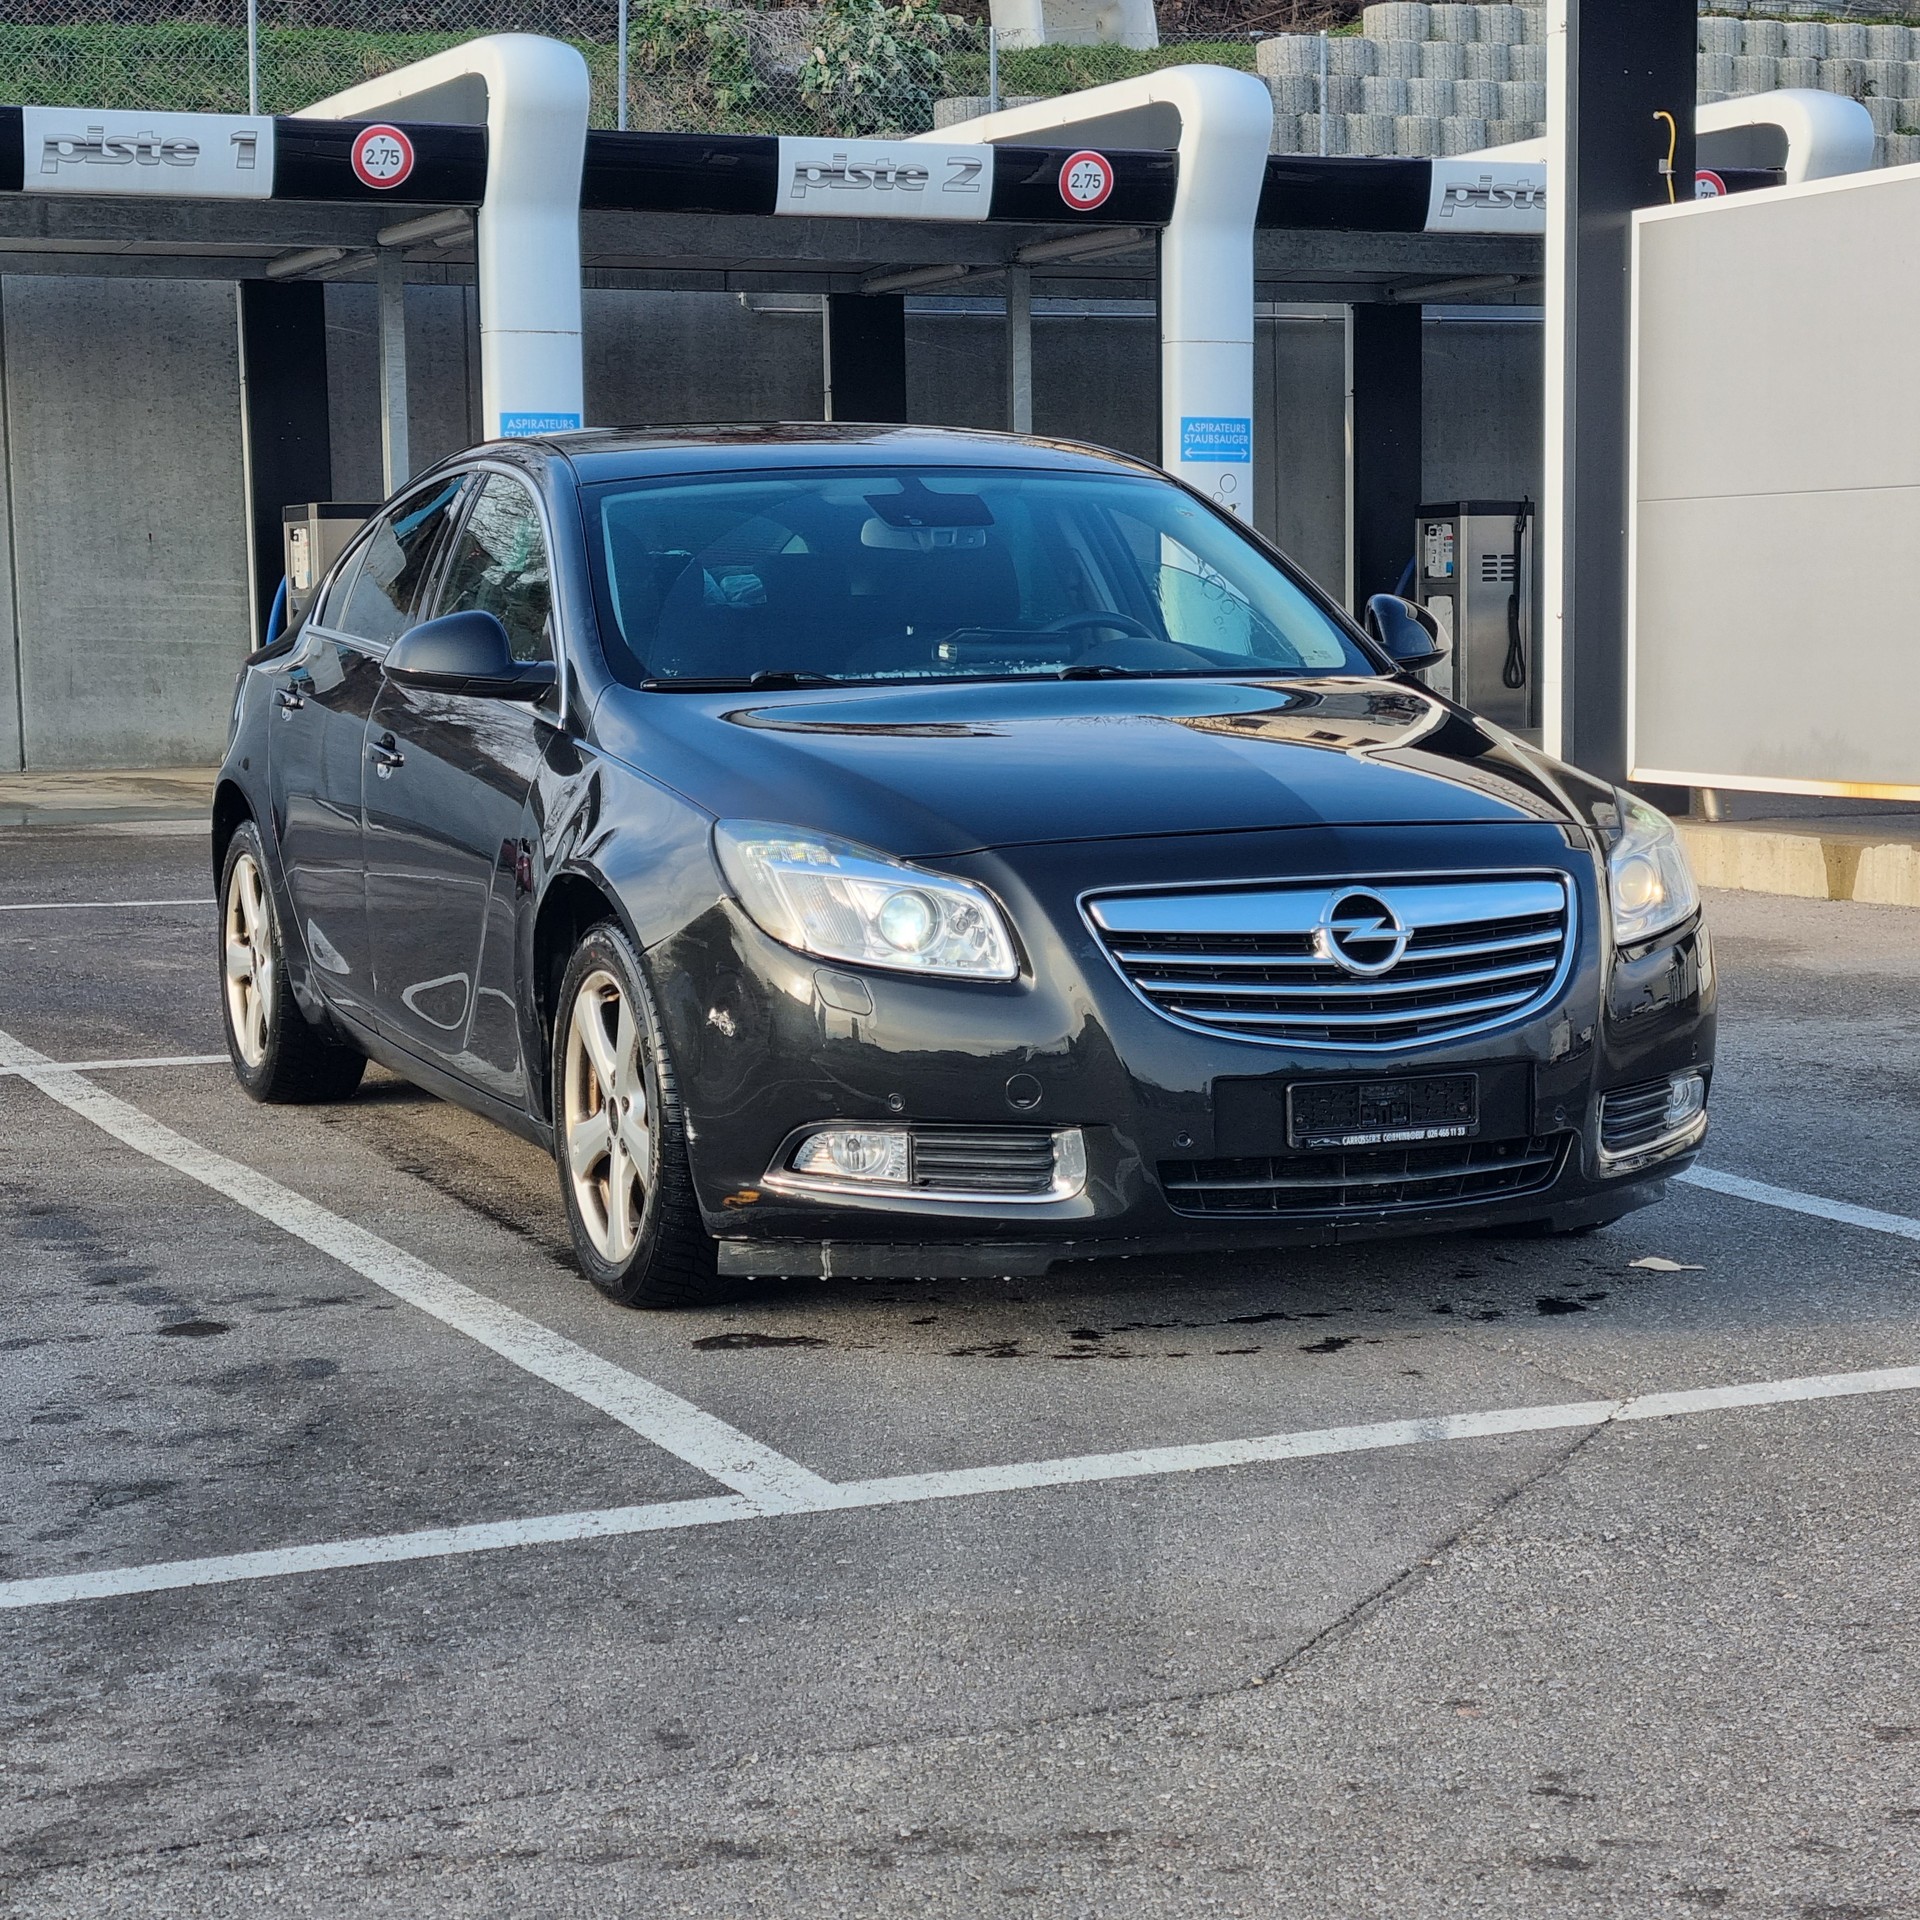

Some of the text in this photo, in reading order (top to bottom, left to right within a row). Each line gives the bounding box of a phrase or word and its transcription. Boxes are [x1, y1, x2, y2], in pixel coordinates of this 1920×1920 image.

[40, 126, 258, 174] piste 1
[365, 148, 400, 166] 2.75
[790, 153, 982, 199] piste 2
[1071, 173, 1102, 189] 2.75
[507, 418, 574, 430] ASPIRATEURS
[1187, 423, 1246, 433] ASPIRATEURS
[1184, 434, 1248, 444] STAUBSAUGER
